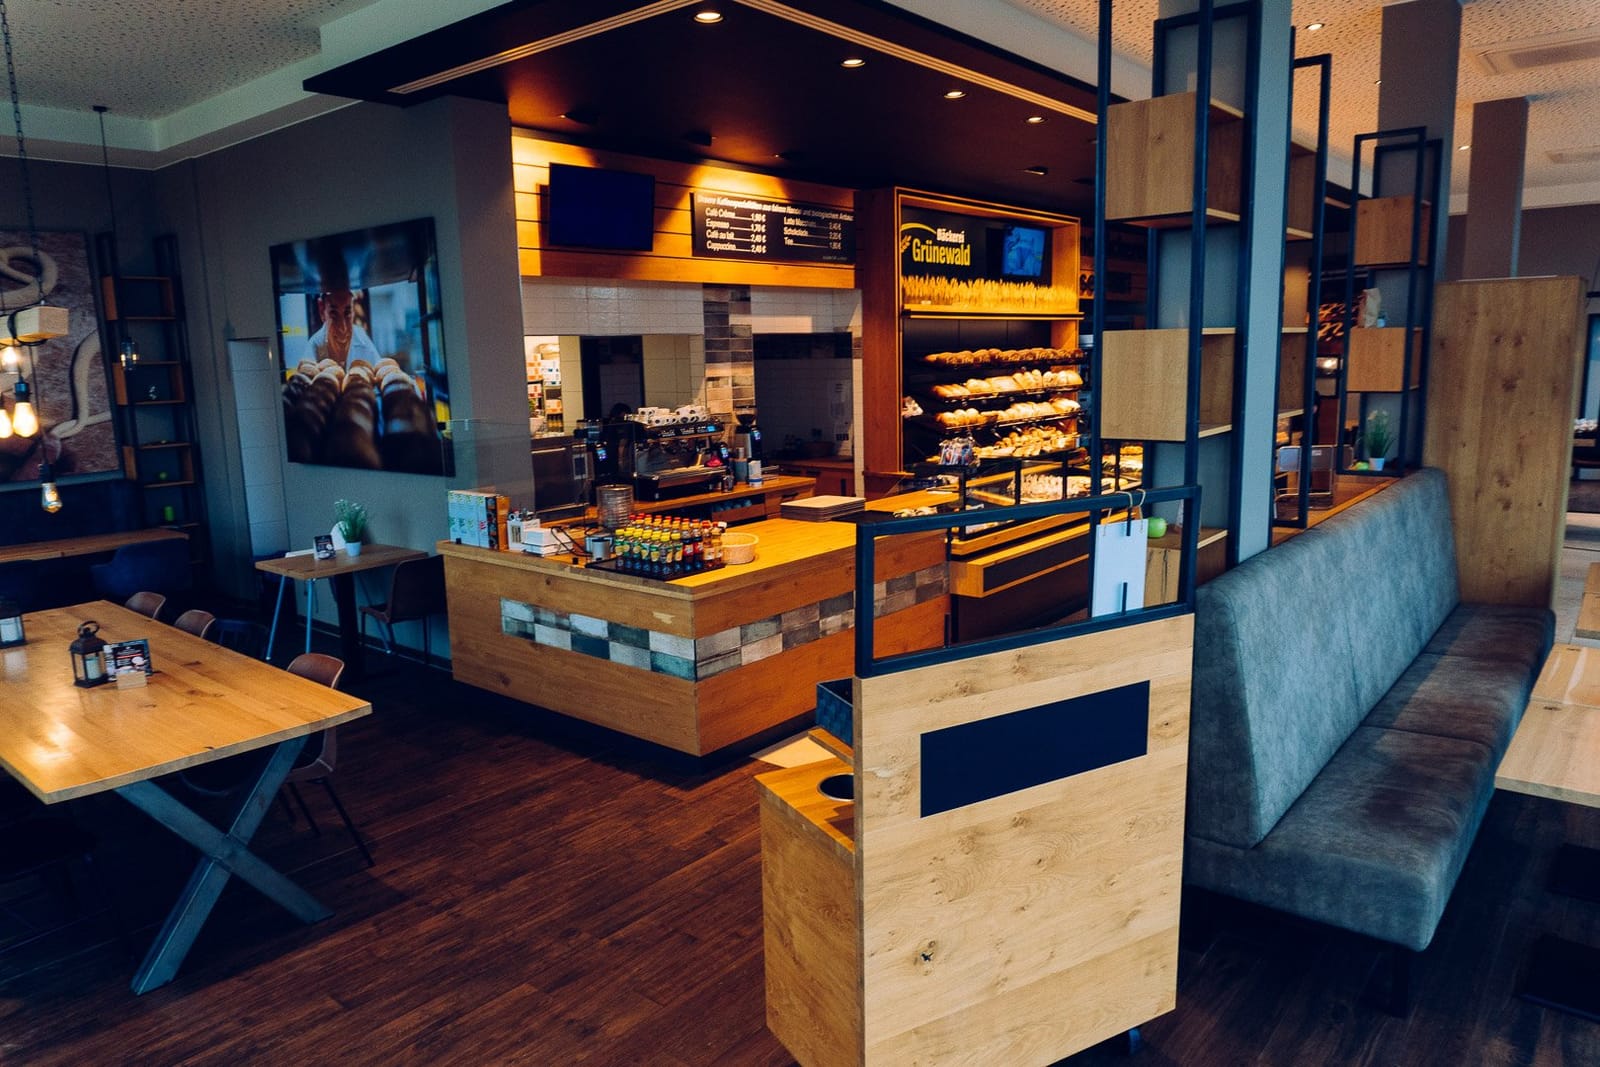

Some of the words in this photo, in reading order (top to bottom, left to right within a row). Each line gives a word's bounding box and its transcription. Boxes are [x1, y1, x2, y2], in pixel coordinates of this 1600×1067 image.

[705, 207, 719, 217] Café
[705, 218, 730, 229] Espresso
[706, 229, 719, 239] Café
[937, 228, 965, 244] Bäckerei
[706, 240, 737, 251] Cappuccino
[912, 238, 971, 267] Grünewald
